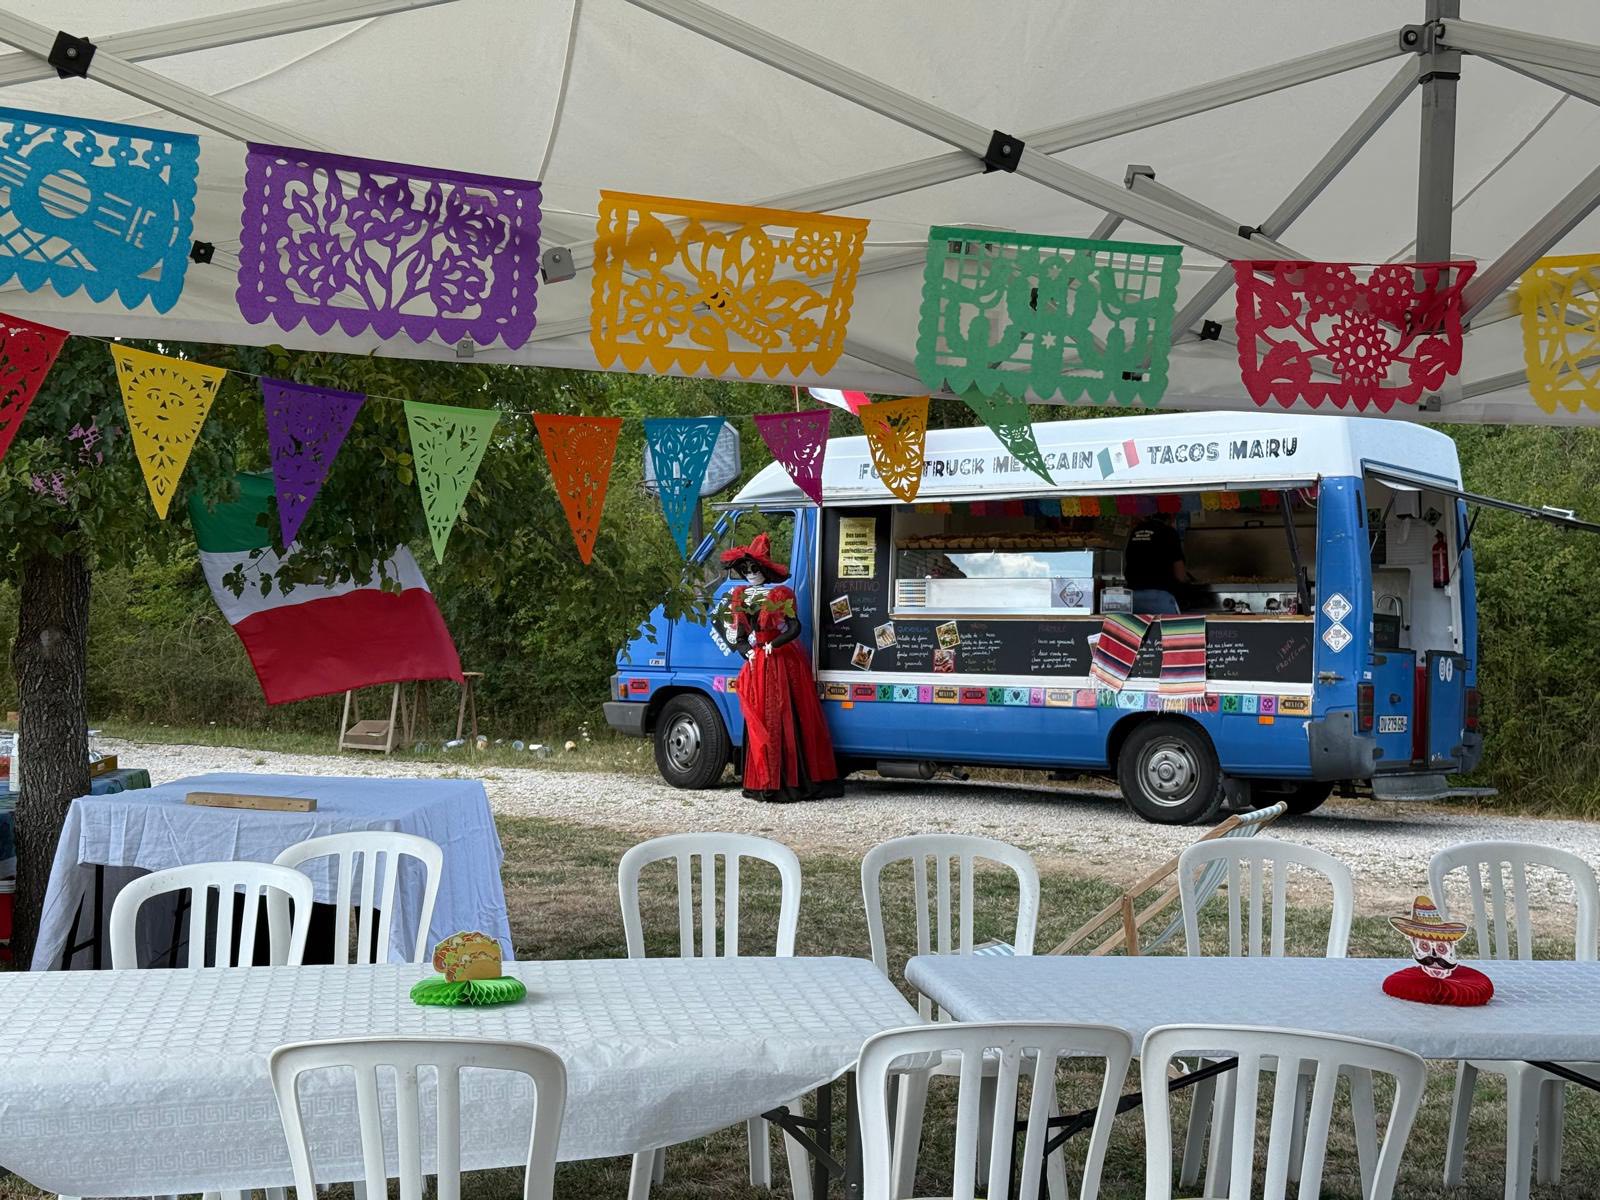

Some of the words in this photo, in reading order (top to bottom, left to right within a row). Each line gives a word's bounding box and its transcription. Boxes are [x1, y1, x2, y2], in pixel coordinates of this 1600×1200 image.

[922, 458, 985, 478] TRUCK
[993, 451, 1093, 474] MECAIN
[1147, 442, 1220, 465] TACOS
[1229, 437, 1298, 460] MARU
[709, 627, 731, 657] TACOS
